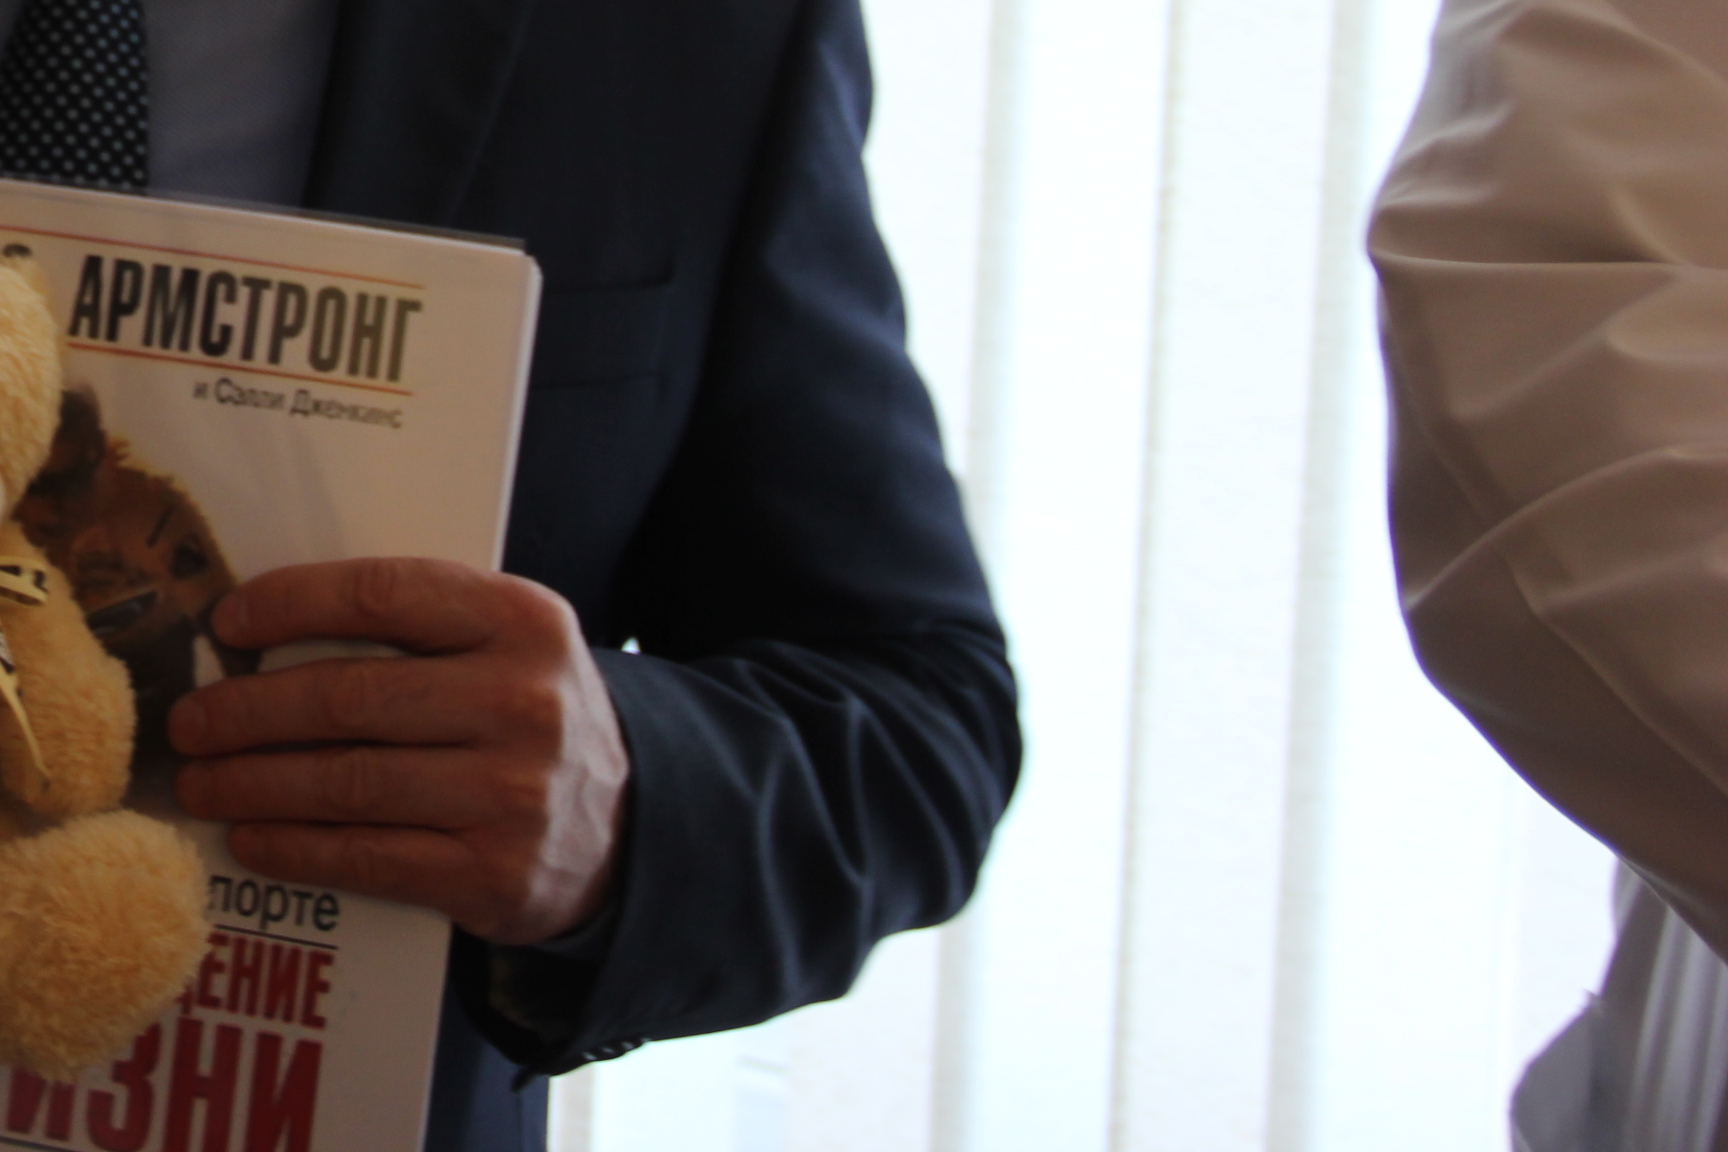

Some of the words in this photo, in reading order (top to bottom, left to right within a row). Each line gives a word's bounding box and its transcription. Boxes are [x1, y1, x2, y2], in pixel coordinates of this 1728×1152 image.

[67, 254, 423, 383] АРМСТРОНГ
[193, 381, 209, 400] и
[290, 388, 403, 429] Дженкинс
[208, 874, 340, 931] порте
